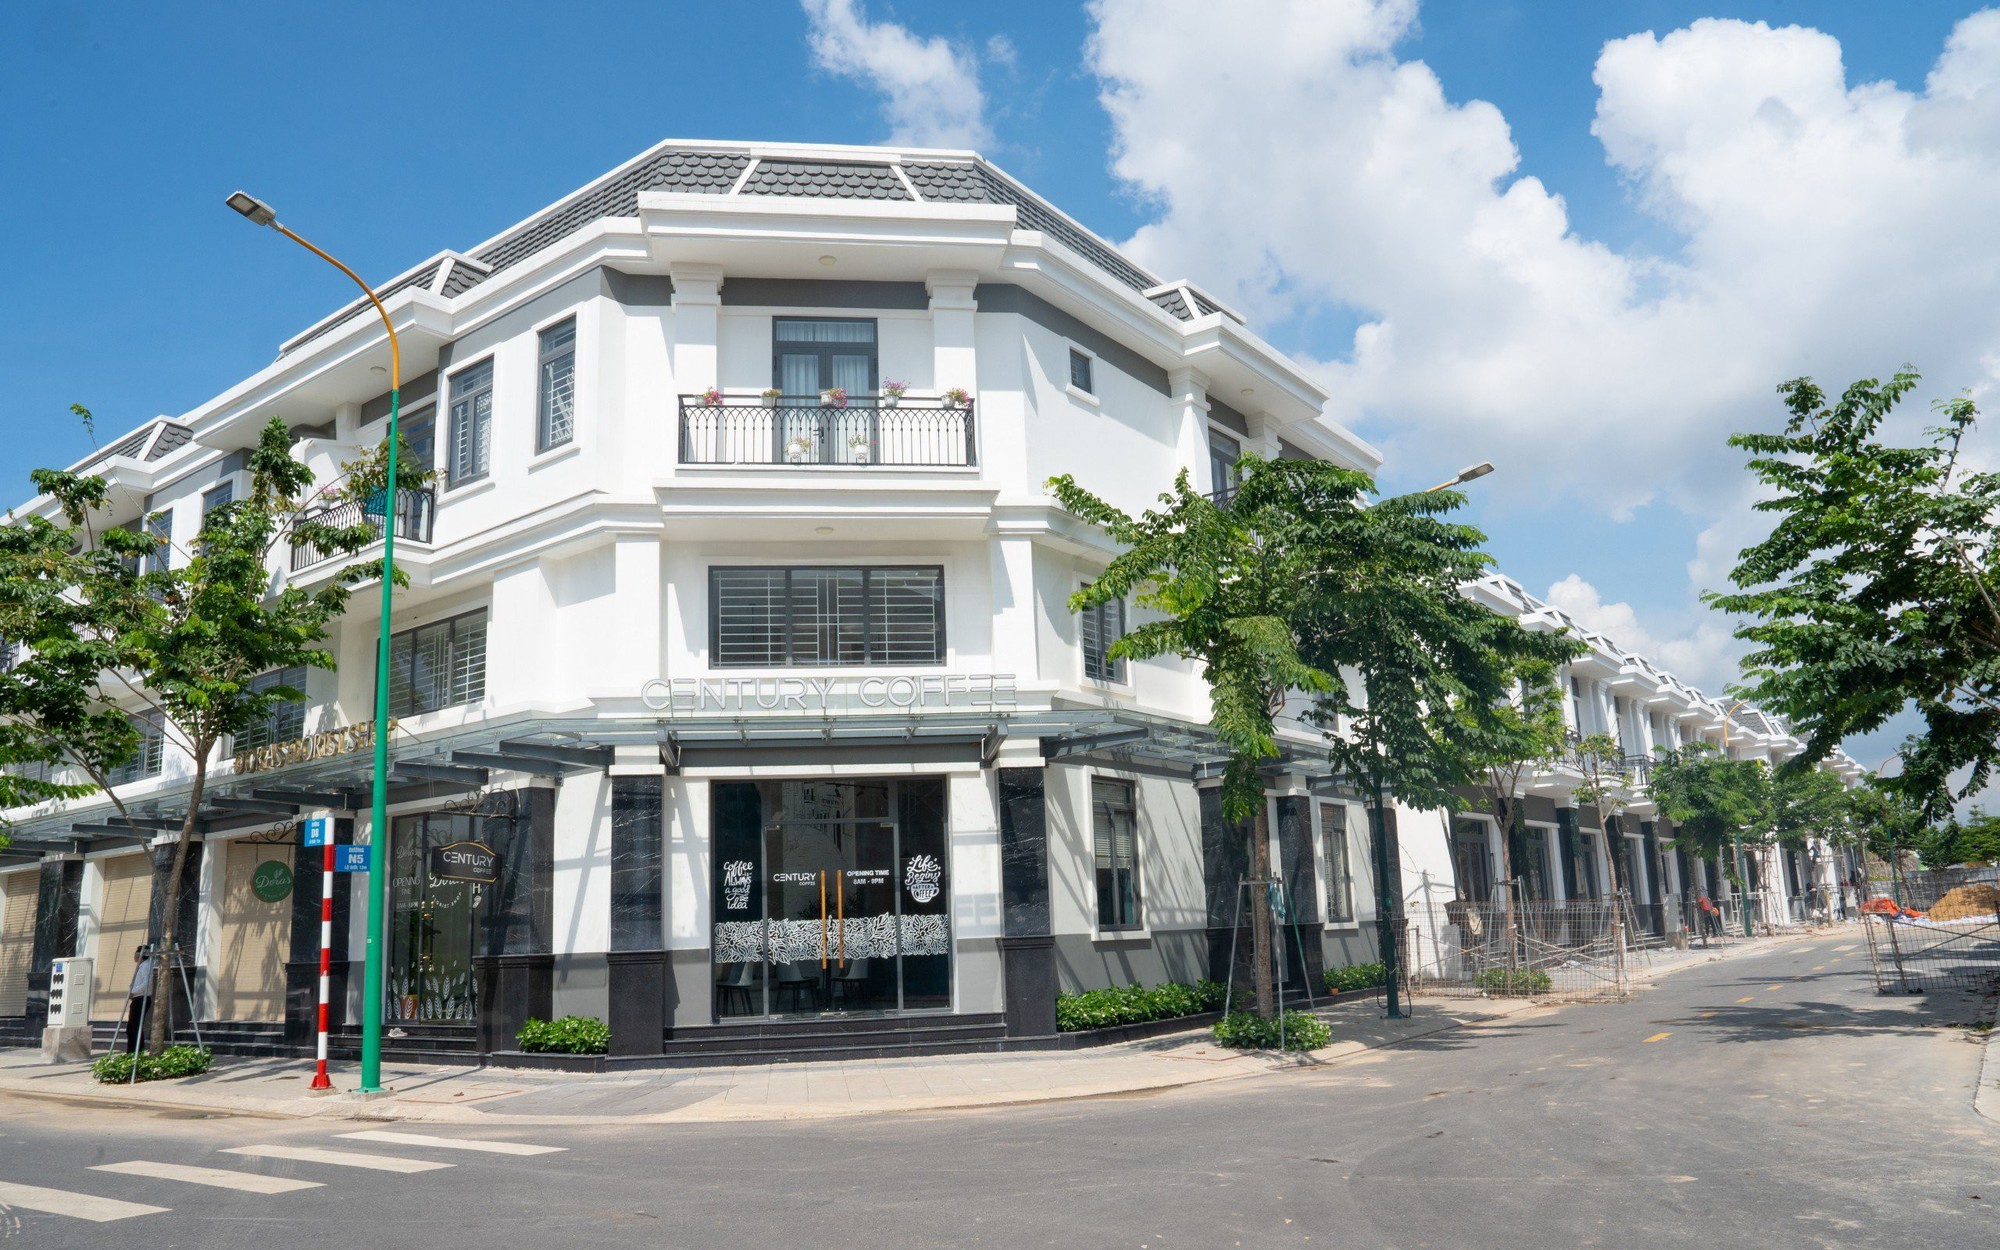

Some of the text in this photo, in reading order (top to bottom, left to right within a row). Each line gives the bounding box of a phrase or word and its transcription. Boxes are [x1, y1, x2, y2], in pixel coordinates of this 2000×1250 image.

[641, 673, 1018, 711] CENTURY COFFEE
[348, 854, 364, 864] N5
[443, 851, 494, 867] CENTURY
[907, 854, 938, 872] Life
[473, 867, 492, 875] COFFEE
[773, 872, 817, 882] CENTURY
[904, 870, 941, 885] Begins
